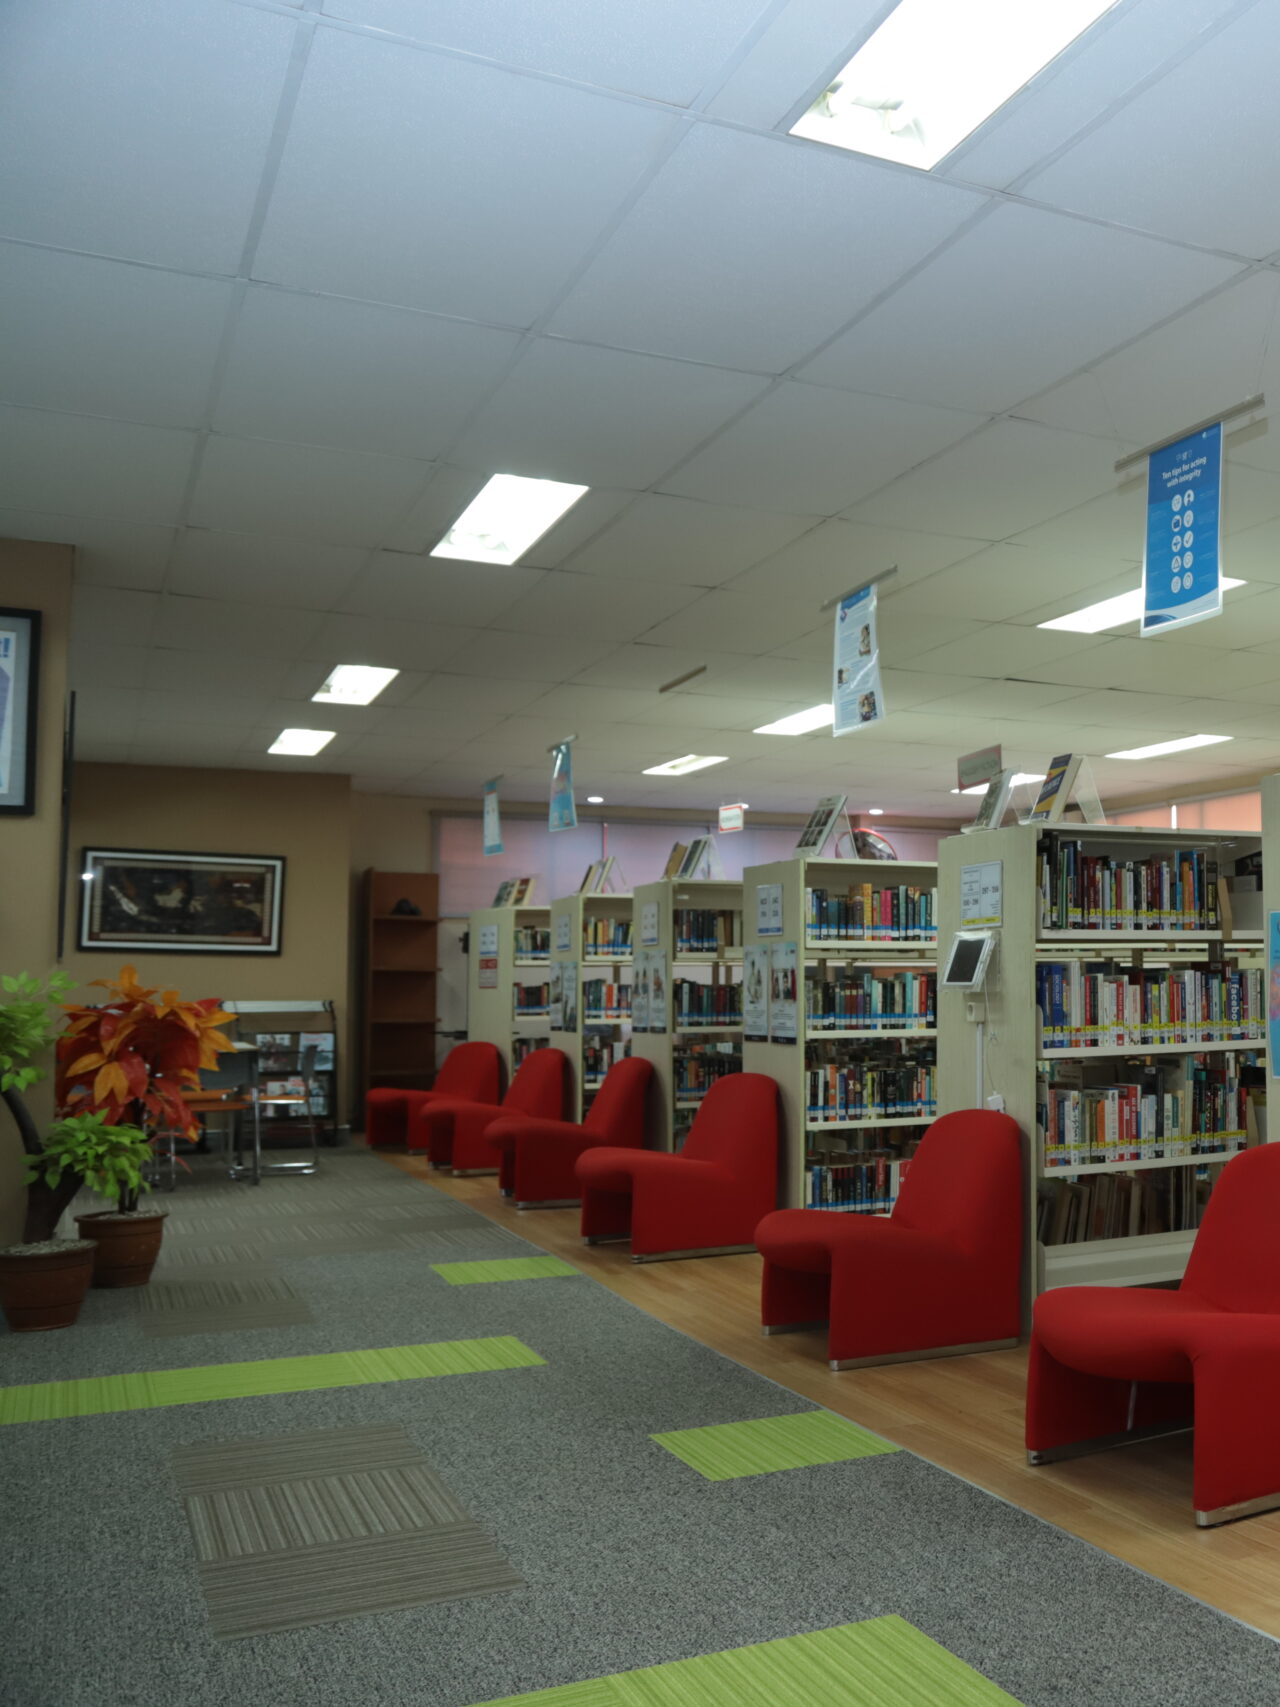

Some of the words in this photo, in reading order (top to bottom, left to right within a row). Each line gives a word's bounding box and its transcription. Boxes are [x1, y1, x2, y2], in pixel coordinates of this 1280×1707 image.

[1162, 472, 1171, 480] Ten
[1172, 467, 1182, 477] tips
[1182, 463, 1190, 472] for
[1230, 982, 1238, 1020] facebo
